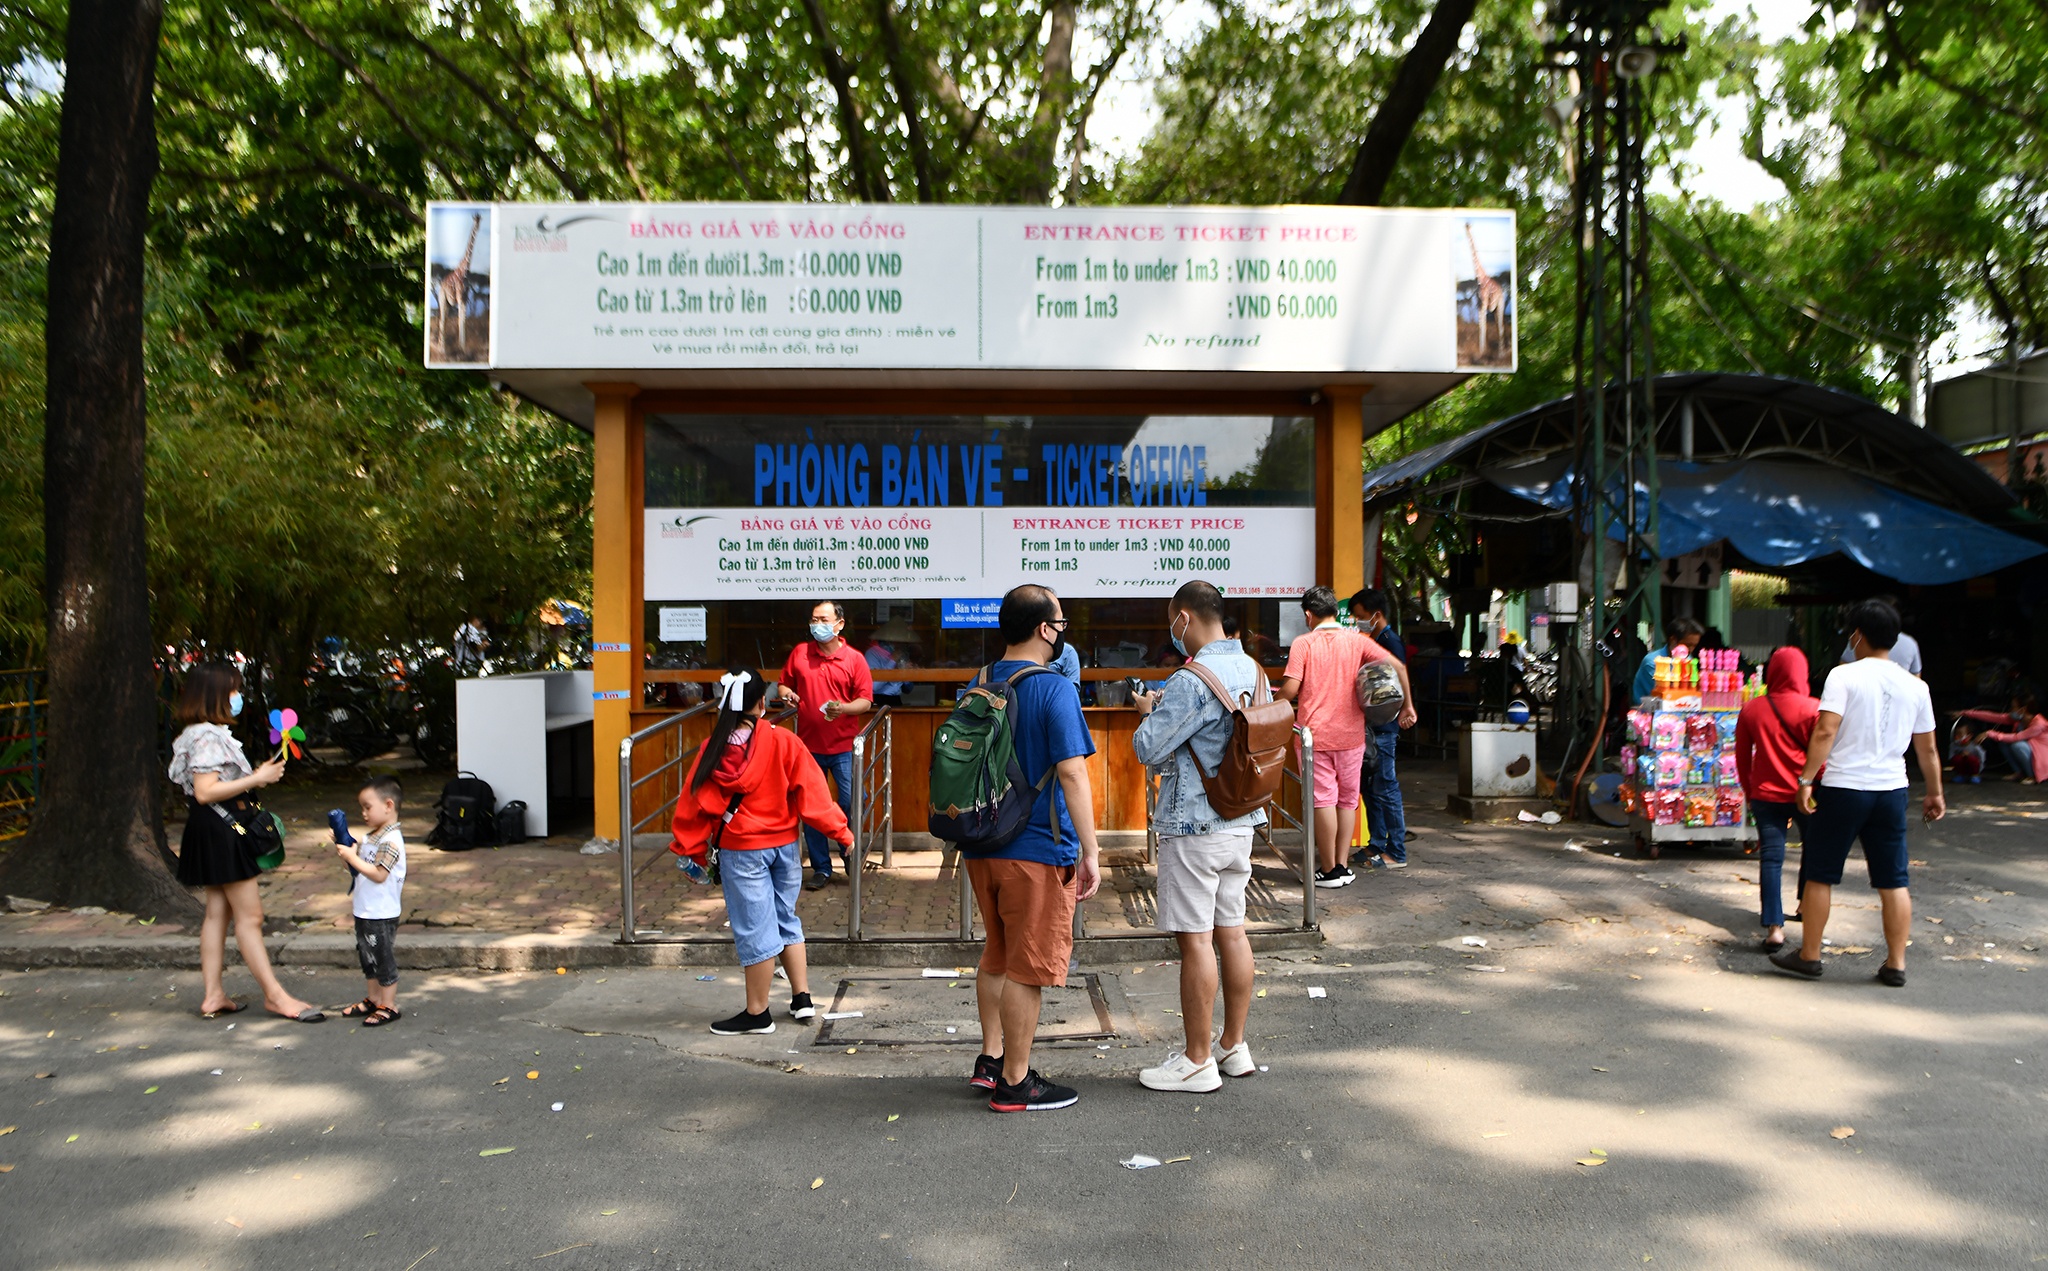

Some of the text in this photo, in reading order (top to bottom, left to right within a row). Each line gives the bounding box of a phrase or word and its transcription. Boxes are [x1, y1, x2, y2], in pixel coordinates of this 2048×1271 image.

[630, 216, 692, 239] BẢNG
[702, 219, 741, 239] GIÁ
[789, 219, 834, 239] VÀO
[843, 215, 906, 240] CỔNG
[1024, 226, 1358, 242] ENTRANCE TICKET PRICE
[597, 251, 629, 276] Cao
[637, 252, 661, 276] 1m
[668, 248, 698, 276] đến
[866, 253, 902, 277] VNĐ
[1036, 256, 1077, 281] From
[1085, 257, 1107, 281] 1m
[1113, 258, 1128, 281] to
[1135, 258, 1178, 282] under
[1186, 258, 1218, 282] 1m3
[1277, 259, 1336, 282] 40.000
[597, 287, 629, 313] Cao
[635, 288, 654, 313] từ
[661, 288, 702, 313] 1.3m
[709, 286, 735, 313] trở
[741, 288, 767, 313] lên
[866, 289, 902, 314] VNĐ
[1036, 294, 1077, 318] From
[1085, 294, 1118, 319] 1m3
[1277, 294, 1337, 319] 60.000
[620, 327, 644, 337] em
[650, 328, 679, 337] cao
[723, 326, 744, 337] 1m
[773, 326, 811, 339] cùng
[817, 326, 840, 339] gia
[938, 326, 956, 337] vé
[653, 344, 673, 354] Vé
[679, 345, 711, 354] mua
[1144, 334, 1261, 350] No refund
[754, 427, 870, 508] PHÒNG
[882, 428, 949, 507] BÁN
[960, 429, 1003, 507] VÉ
[1043, 443, 1123, 508] TICKET
[1130, 444, 1207, 508] OFFICE
[741, 513, 931, 531] BẢNG GIÁ VÉ VÀO CỔNG
[1013, 518, 1245, 529] ENTRANCE TICKET PRICE
[719, 538, 740, 551] Cao
[746, 538, 763, 551] 1m
[767, 536, 789, 551] đến
[904, 537, 929, 550] VNĐ
[1021, 538, 1050, 551] From
[1054, 538, 1071, 551] 1m
[1075, 539, 1086, 551] to
[1089, 538, 1120, 551] under
[1125, 538, 1148, 551] 1m3
[1188, 538, 1231, 551] 40.000
[719, 557, 740, 571] Cao
[745, 557, 759, 571] từ
[763, 557, 792, 571] 1.3m
[796, 555, 814, 571] trở
[818, 556, 836, 570] lên
[904, 556, 929, 570] VNĐ
[1021, 558, 1050, 571] From
[1054, 558, 1078, 571] 1m3
[1188, 557, 1231, 571] 60.000
[870, 576, 887, 584] gia
[1096, 578, 1178, 587] No refund
[954, 602, 1001, 613] Bán vé onlin
